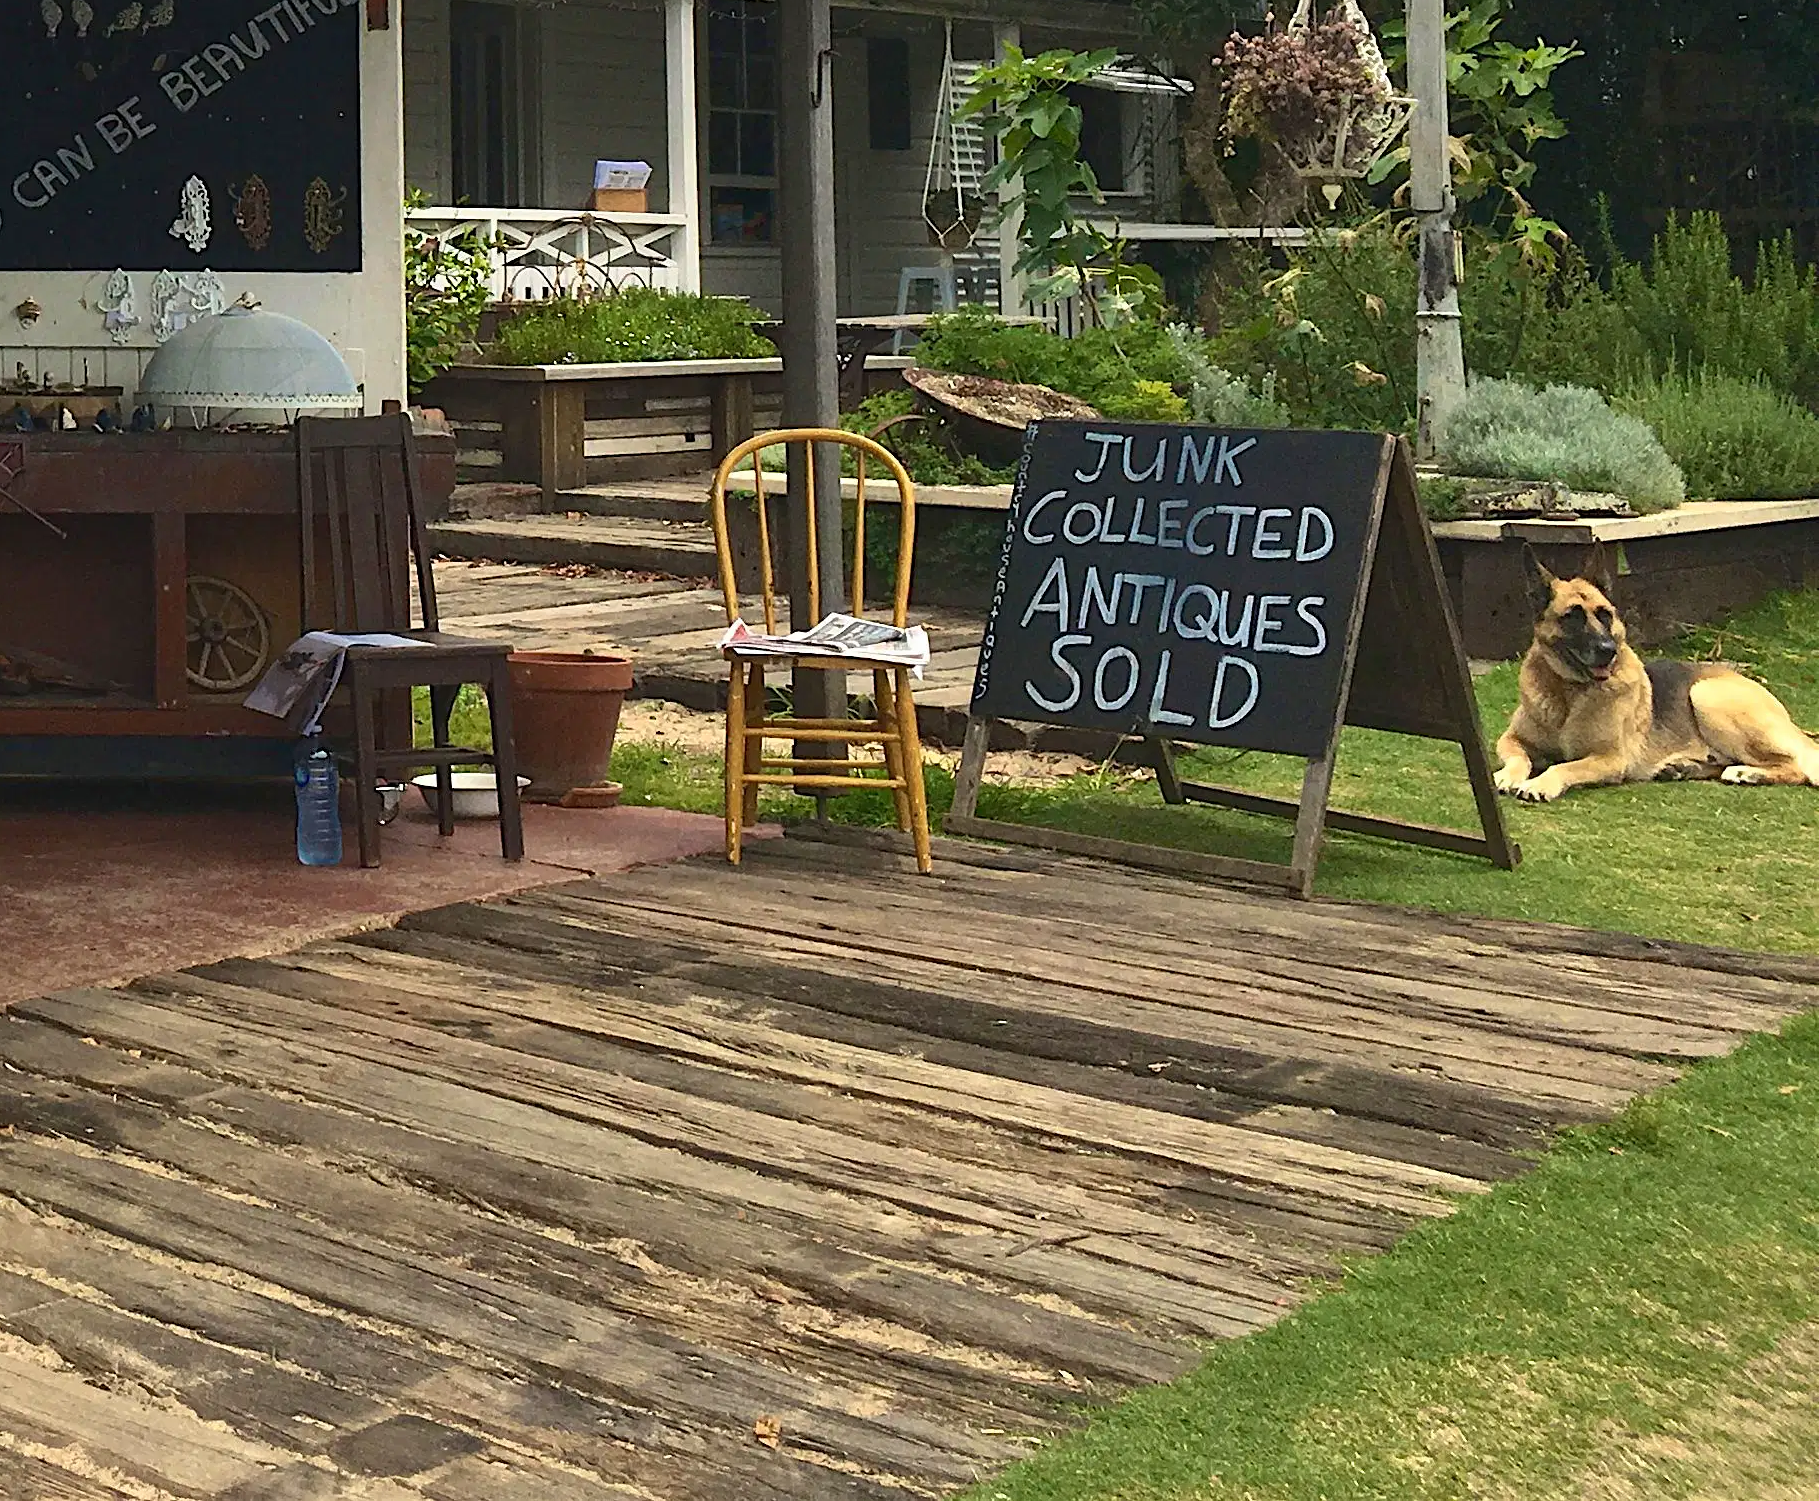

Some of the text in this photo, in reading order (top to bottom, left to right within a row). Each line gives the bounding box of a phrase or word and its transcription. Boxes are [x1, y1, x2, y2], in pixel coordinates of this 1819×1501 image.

[13, 134, 95, 208] CAN
[95, 96, 157, 154] BE
[1074, 432, 1257, 487] JUNK
[1023, 490, 1334, 562] COLLECTED
[1020, 557, 1327, 656] ANTIQUES
[1025, 634, 1259, 729] SOLD
